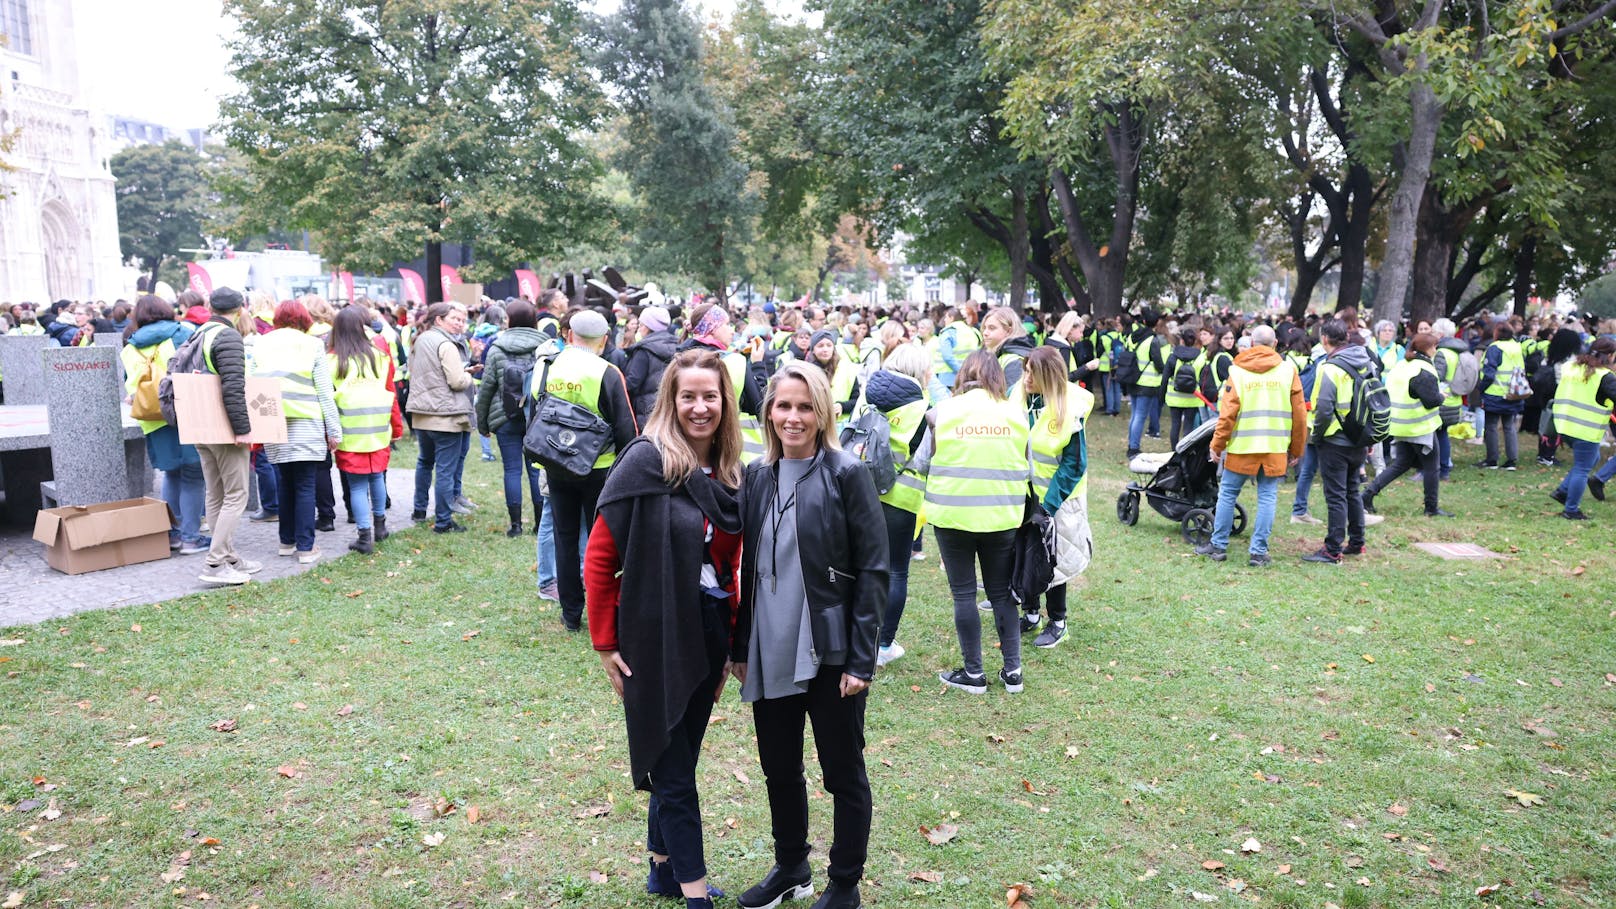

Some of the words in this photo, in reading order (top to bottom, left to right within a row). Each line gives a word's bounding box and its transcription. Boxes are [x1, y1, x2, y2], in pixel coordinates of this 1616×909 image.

[54, 361, 110, 372] SLOWAKEI
[547, 382, 582, 392] ouon
[955, 425, 1011, 439] younion
